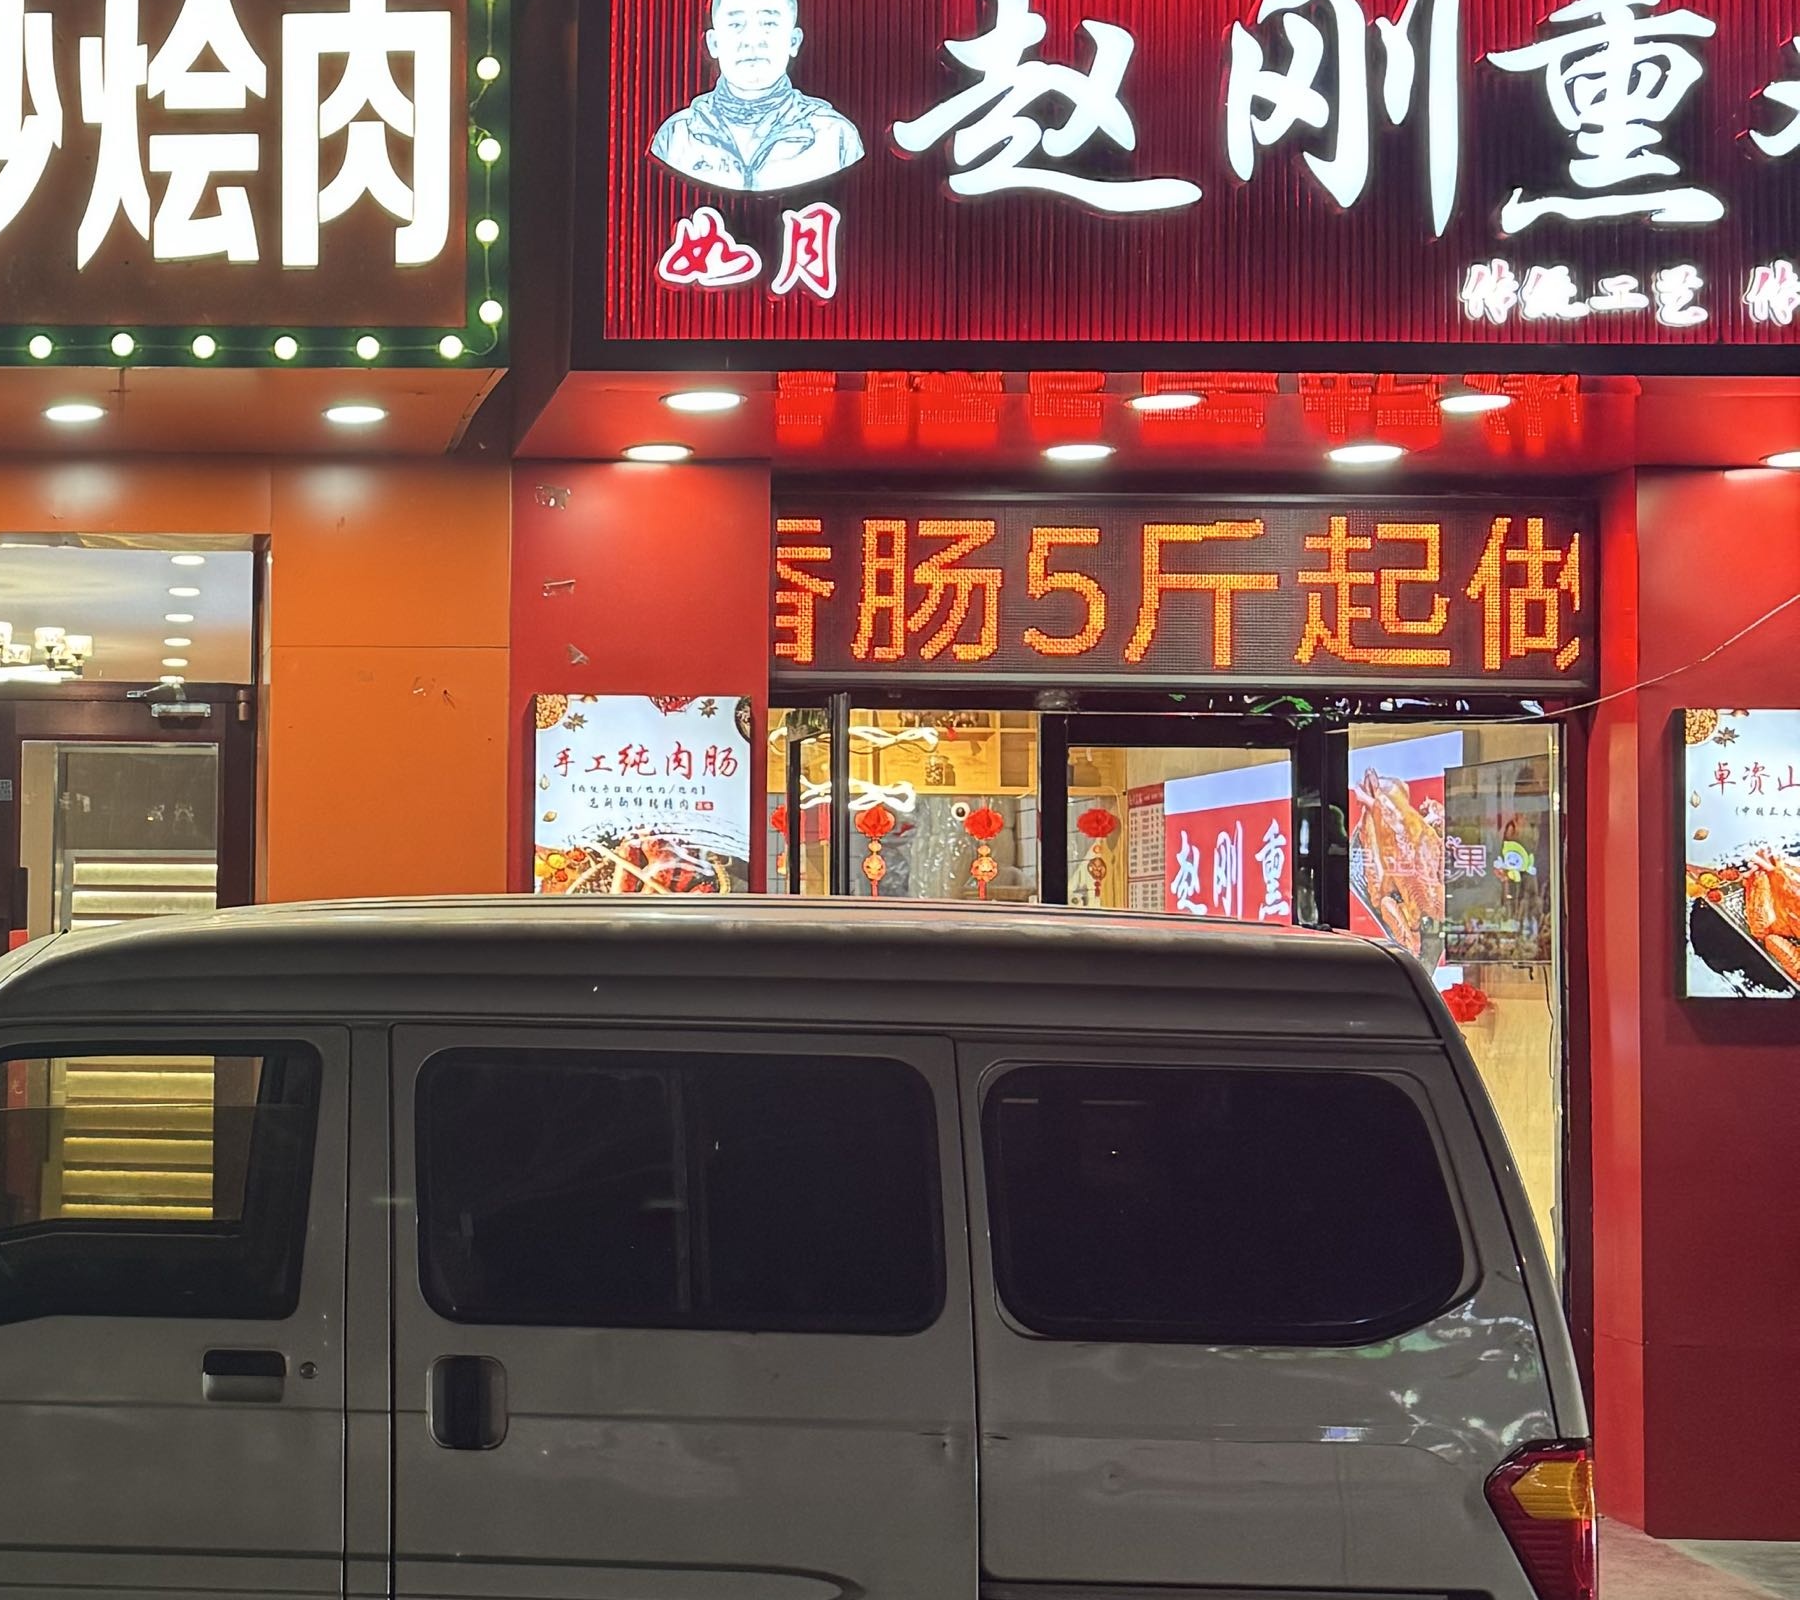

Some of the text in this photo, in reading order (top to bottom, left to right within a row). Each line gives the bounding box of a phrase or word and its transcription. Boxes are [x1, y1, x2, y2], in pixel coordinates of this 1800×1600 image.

[554, 740, 739, 780] 手工纯肉肠
[1170, 818, 1290, 921] 赵刚熏
